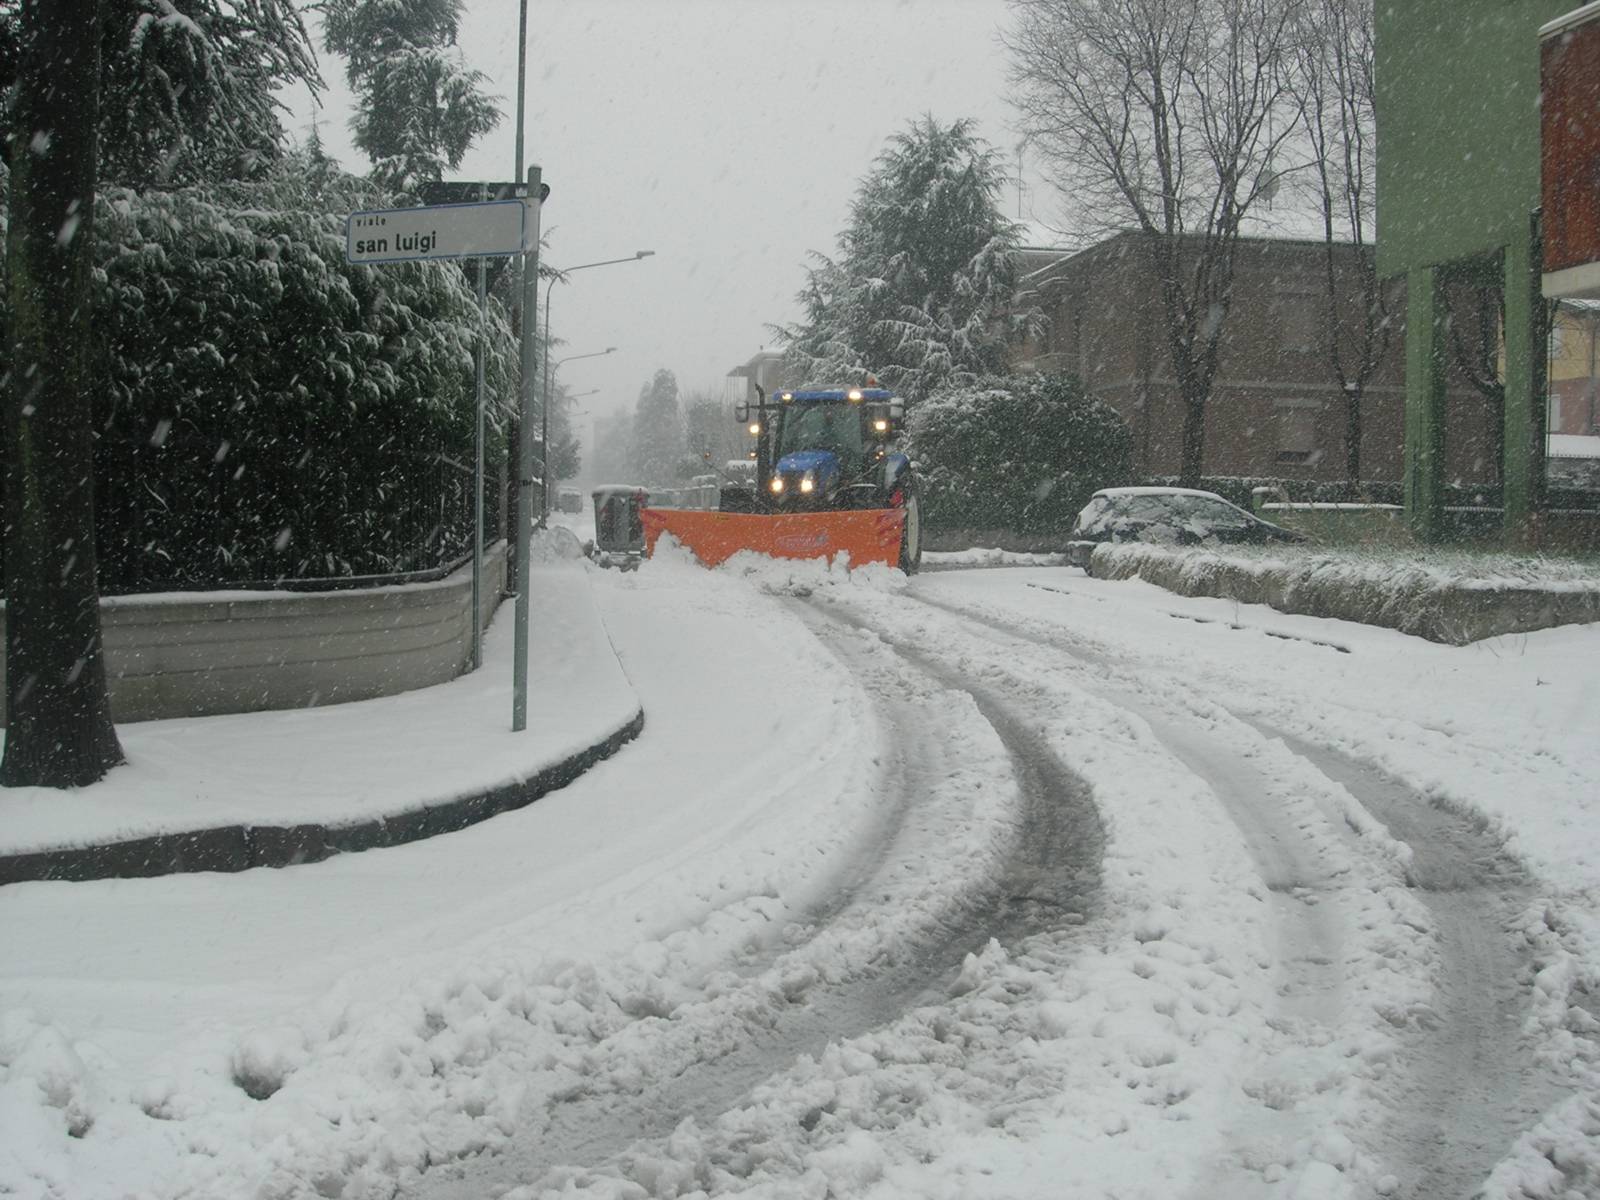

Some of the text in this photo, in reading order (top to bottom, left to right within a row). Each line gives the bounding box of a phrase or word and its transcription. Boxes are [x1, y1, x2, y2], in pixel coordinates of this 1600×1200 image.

[356, 215, 386, 227] viale
[356, 230, 436, 254] san luigi
